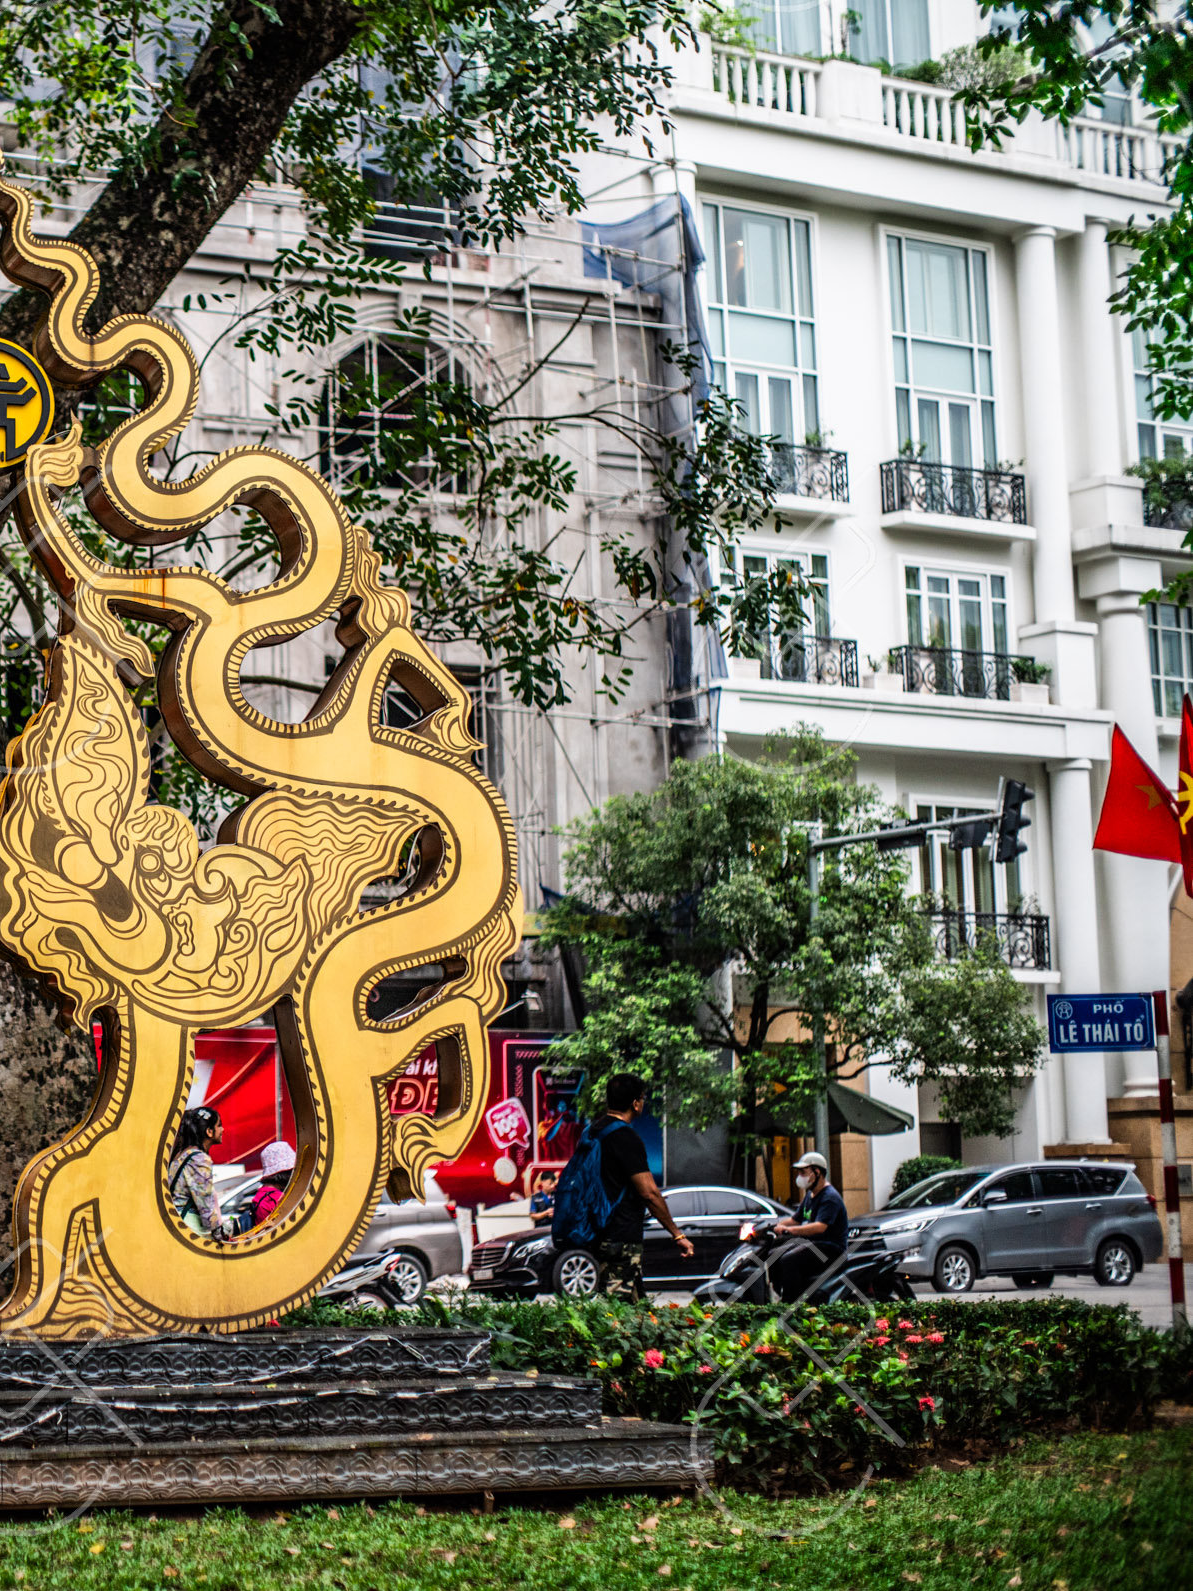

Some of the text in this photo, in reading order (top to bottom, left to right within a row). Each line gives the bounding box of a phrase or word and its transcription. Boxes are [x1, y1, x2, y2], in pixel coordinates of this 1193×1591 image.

[1059, 1014, 1145, 1044] LÊ THÁI TỔ
